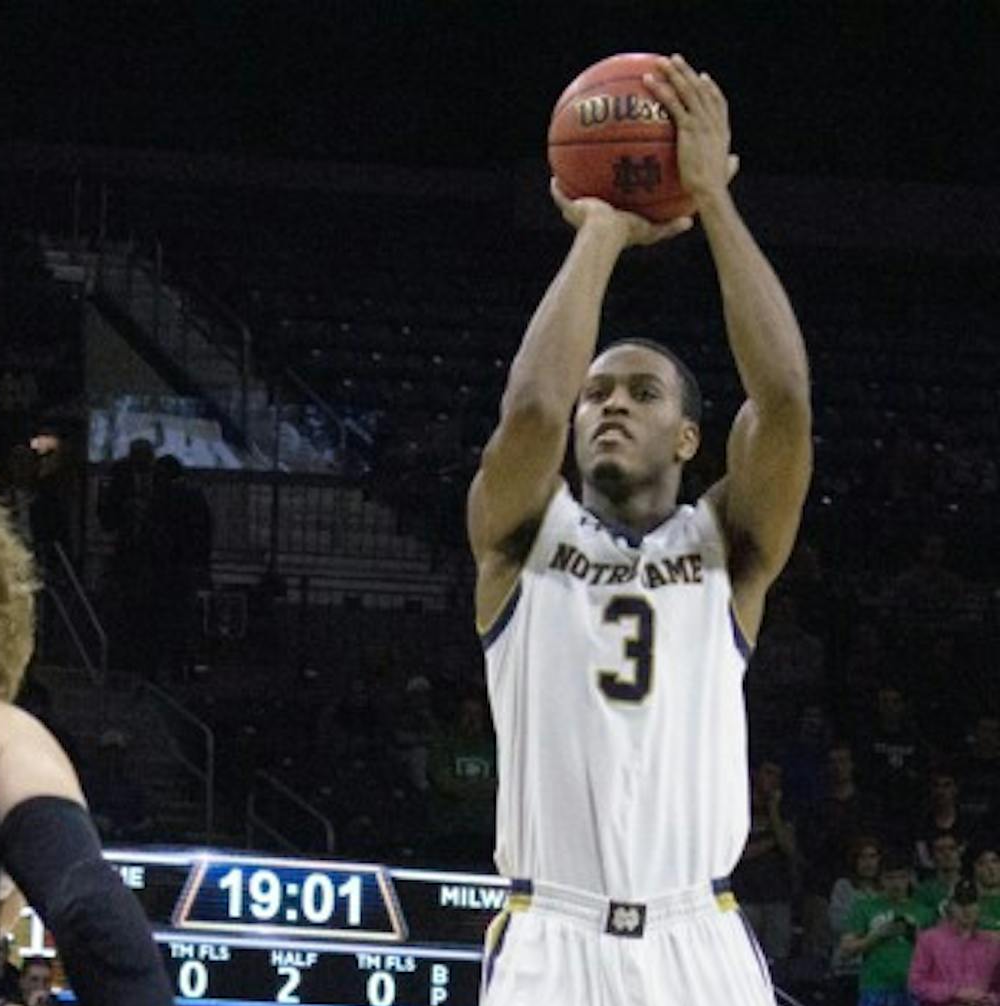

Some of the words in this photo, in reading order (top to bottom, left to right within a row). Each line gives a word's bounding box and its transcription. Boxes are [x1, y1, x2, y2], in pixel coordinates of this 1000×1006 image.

[643, 554, 703, 588] AME
[598, 595, 655, 706] 3
[219, 868, 362, 926] 19:01
[441, 886, 505, 909] MILW
[170, 943, 195, 959] TM
[200, 945, 231, 961] FLS
[272, 951, 317, 968] HALF
[356, 954, 382, 969] TM
[385, 956, 415, 972] FLS
[179, 961, 208, 998] 0
[276, 966, 302, 1004] 2
[432, 964, 449, 985] B
[430, 987, 448, 1006] P
